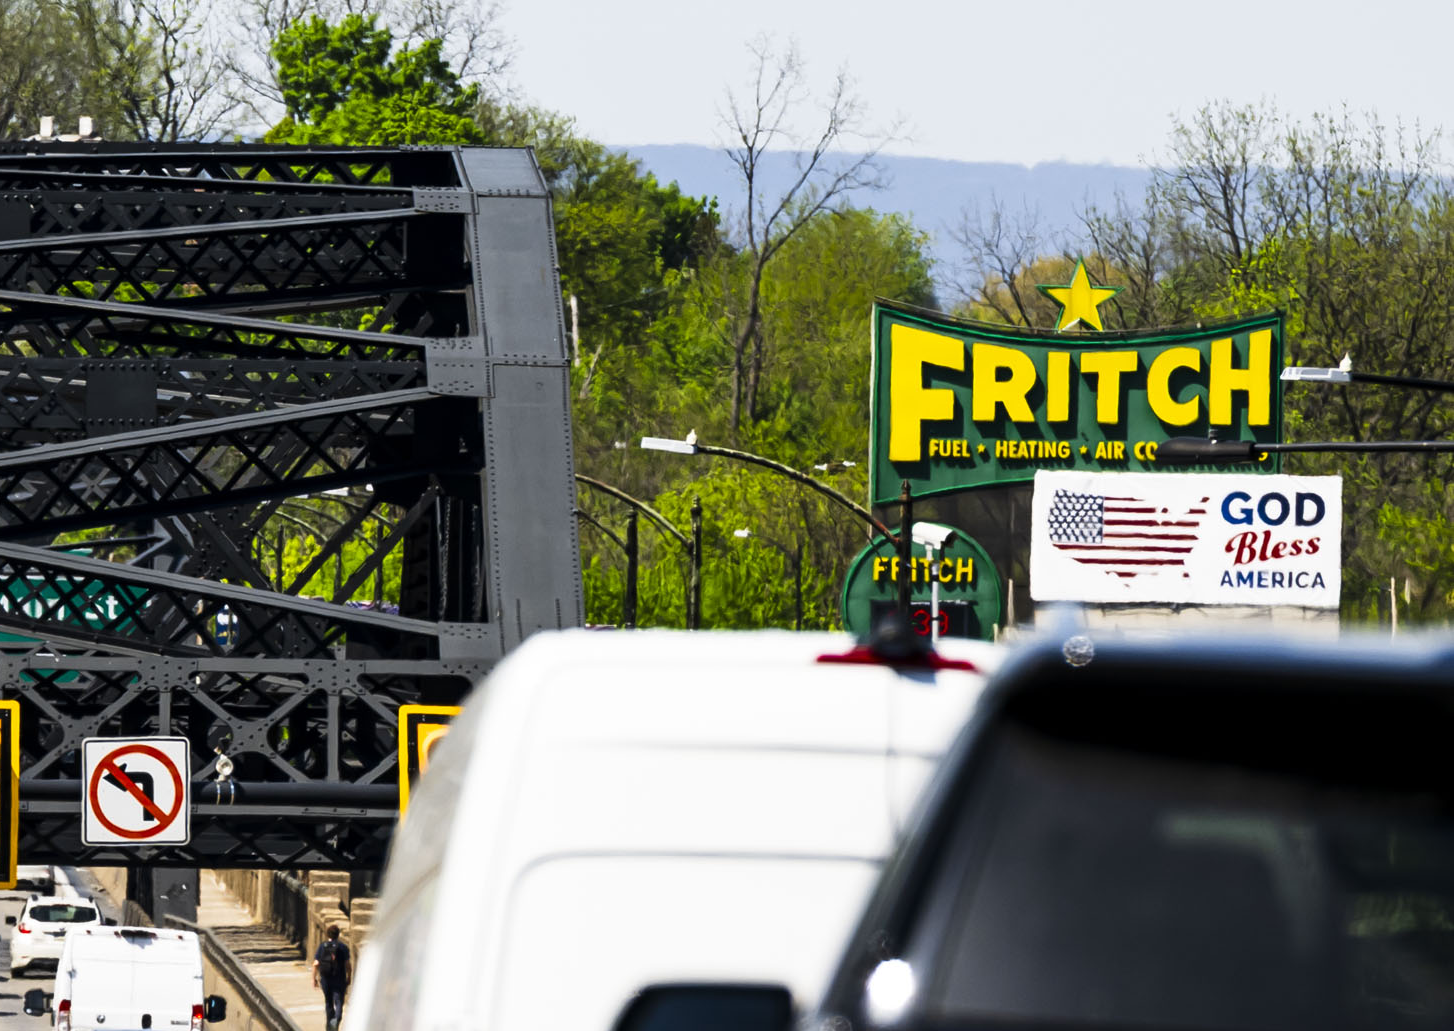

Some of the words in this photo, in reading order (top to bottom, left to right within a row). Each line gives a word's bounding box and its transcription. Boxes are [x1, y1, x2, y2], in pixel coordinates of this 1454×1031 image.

[888, 323, 1273, 462] FRITCH
[928, 438, 971, 458] FUEL
[995, 439, 1071, 459] HEATING
[1095, 441, 1125, 460] AIR
[1220, 491, 1325, 527] GOD
[1224, 529, 1321, 566] Bless
[1219, 570, 1326, 589] AMERICA
